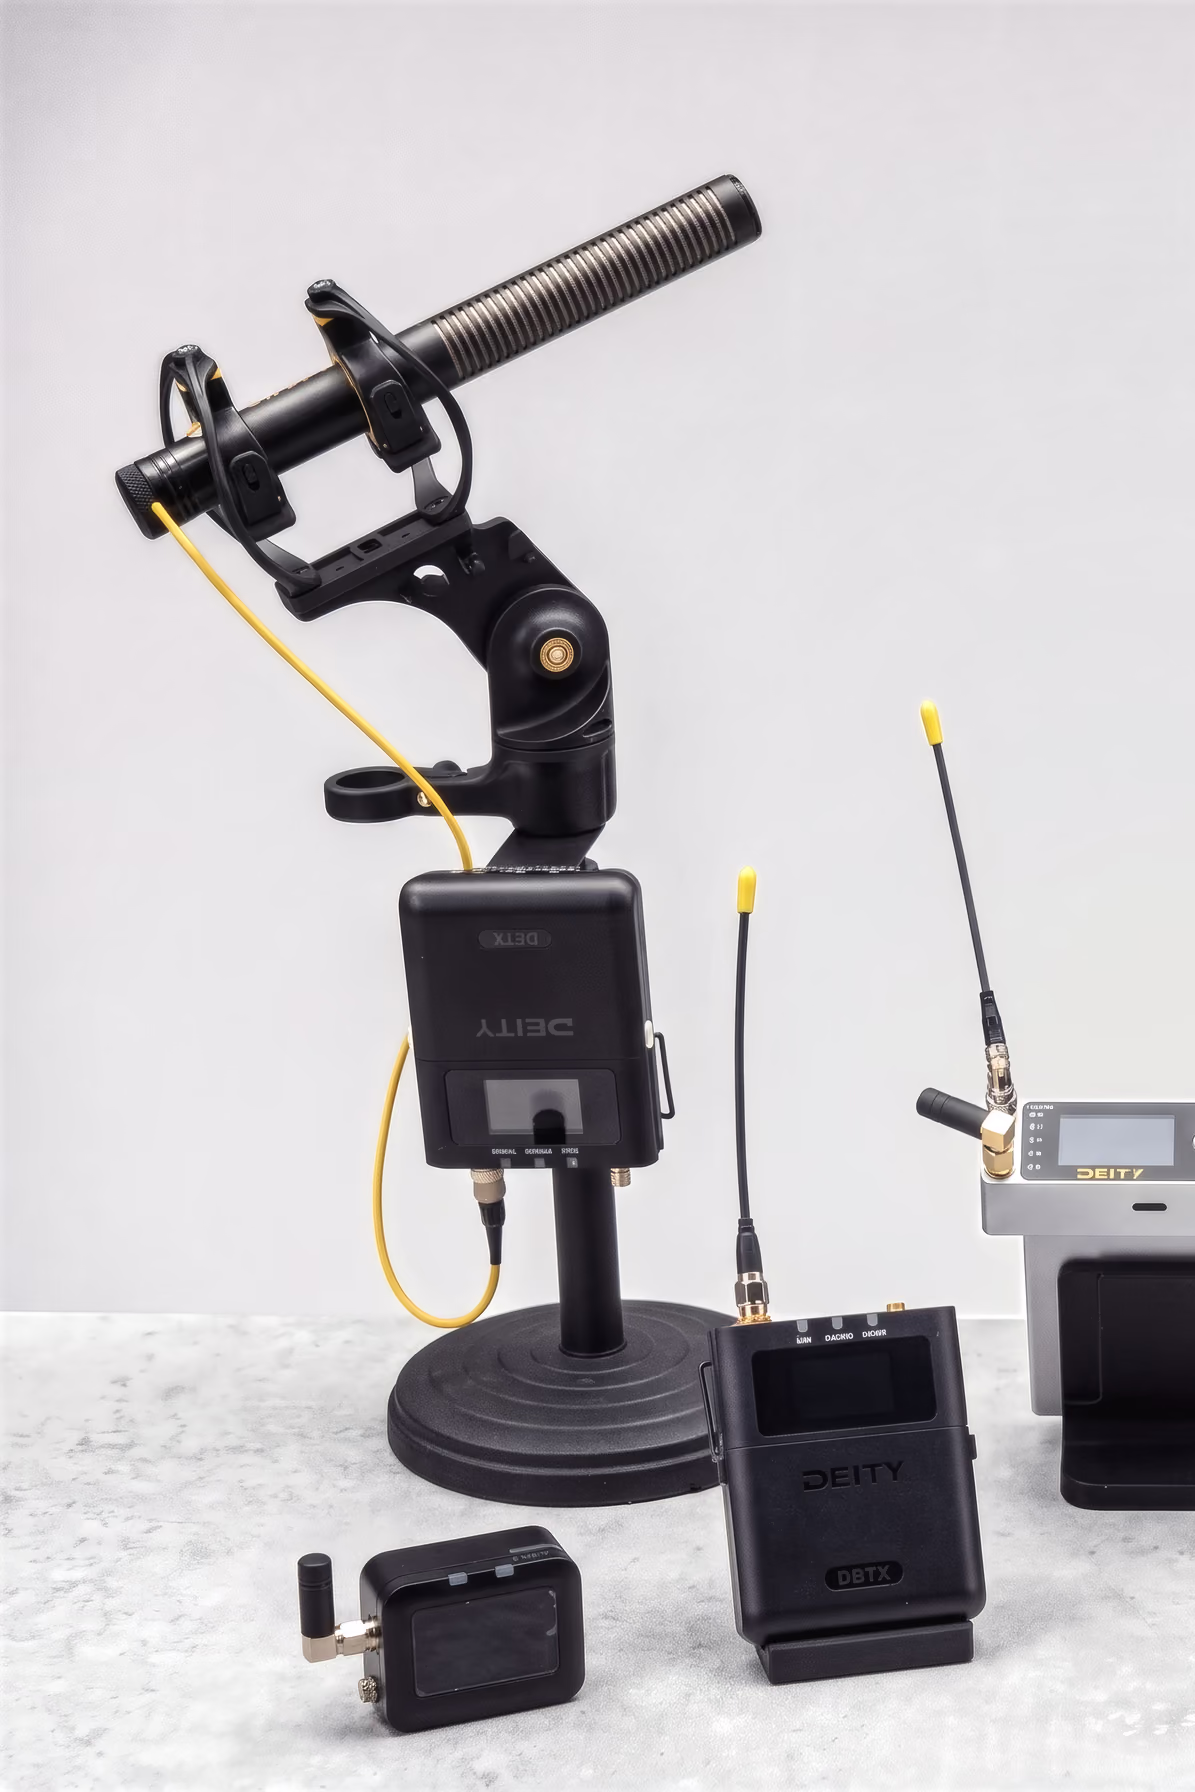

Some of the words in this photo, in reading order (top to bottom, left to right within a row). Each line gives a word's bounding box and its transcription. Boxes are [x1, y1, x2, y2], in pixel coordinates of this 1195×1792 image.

[476, 1017, 574, 1038] DEITY
[1076, 1167, 1145, 1180] DEITY
[802, 1460, 905, 1492] DEITY
[837, 1564, 891, 1586] DBTX
